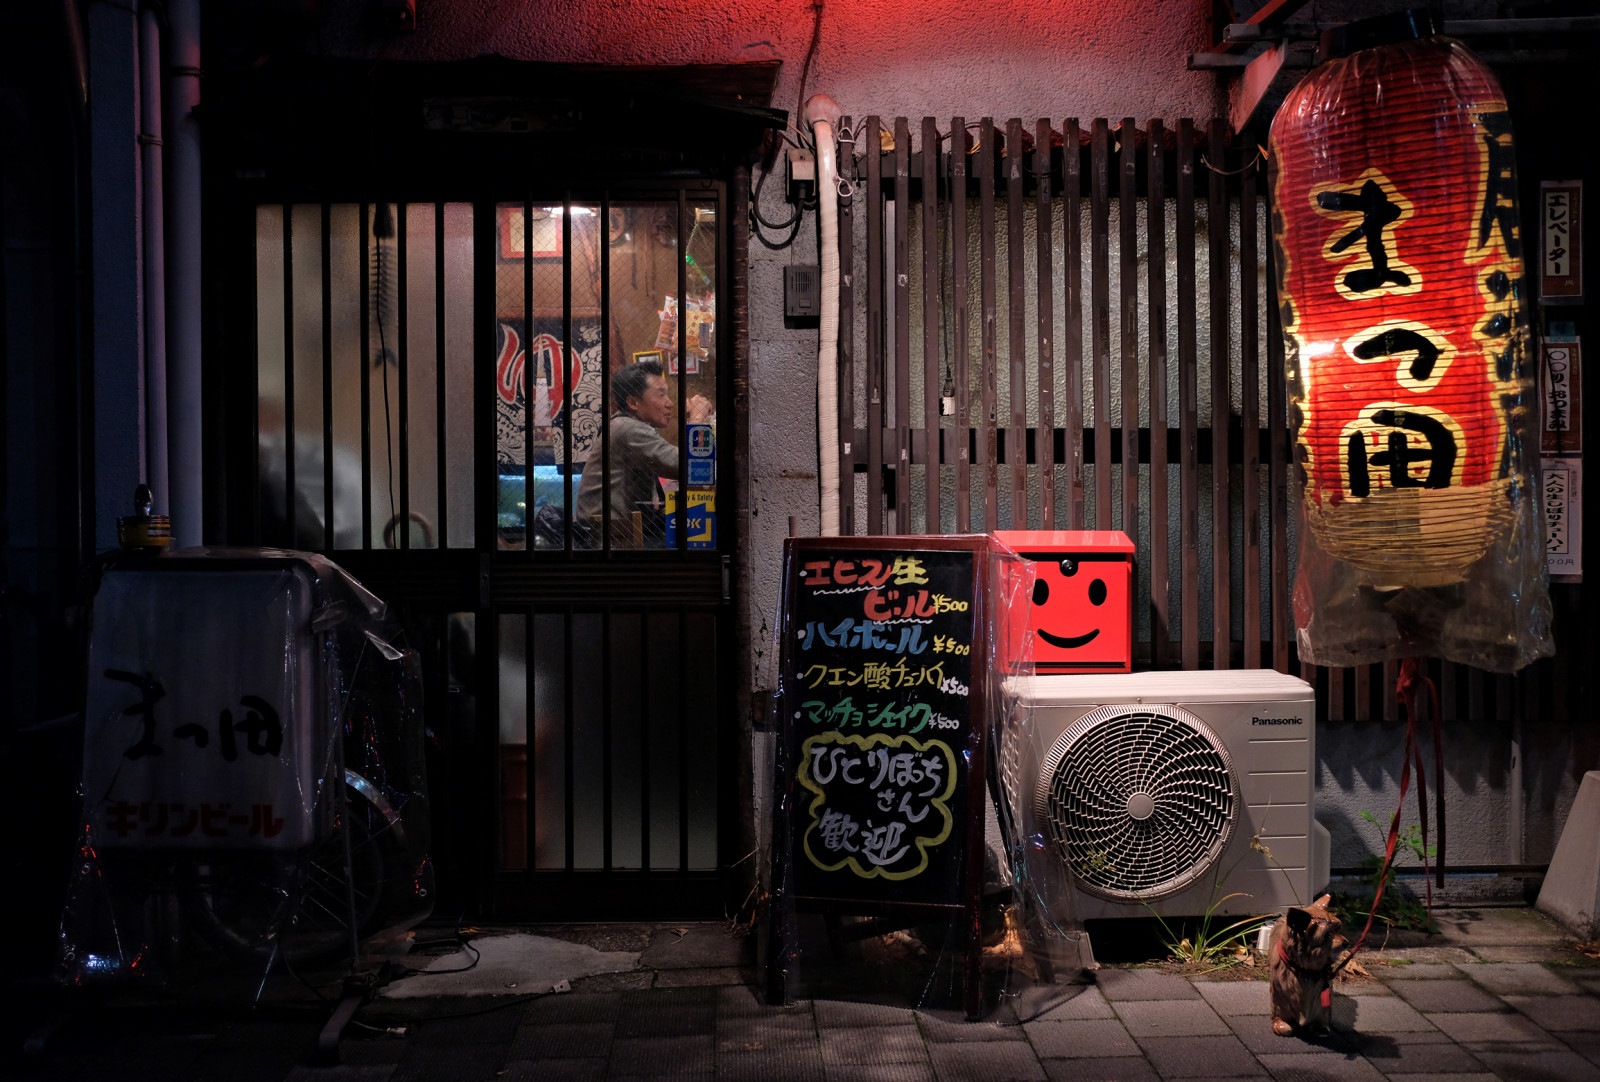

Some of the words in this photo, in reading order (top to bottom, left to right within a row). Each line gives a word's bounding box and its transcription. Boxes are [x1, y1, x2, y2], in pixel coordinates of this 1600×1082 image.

[1548, 195, 1568, 274] エレベーター
[1317, 179, 1458, 497] まつ田
[864, 590, 935, 621] ビール
[932, 594, 968, 614] ¥500
[802, 618, 928, 656] ハイボール
[933, 634, 970, 656] ¥500
[803, 656, 945, 690] クエン酸チューハイ
[940, 677, 969, 696] ¥500
[928, 711, 960, 730] ¥500
[1252, 716, 1302, 725] Panasonic
[811, 747, 943, 797] ひとりぼっち
[107, 802, 284, 838] キリンビール
[877, 789, 930, 823] さん
[819, 808, 911, 865] 歓迎
